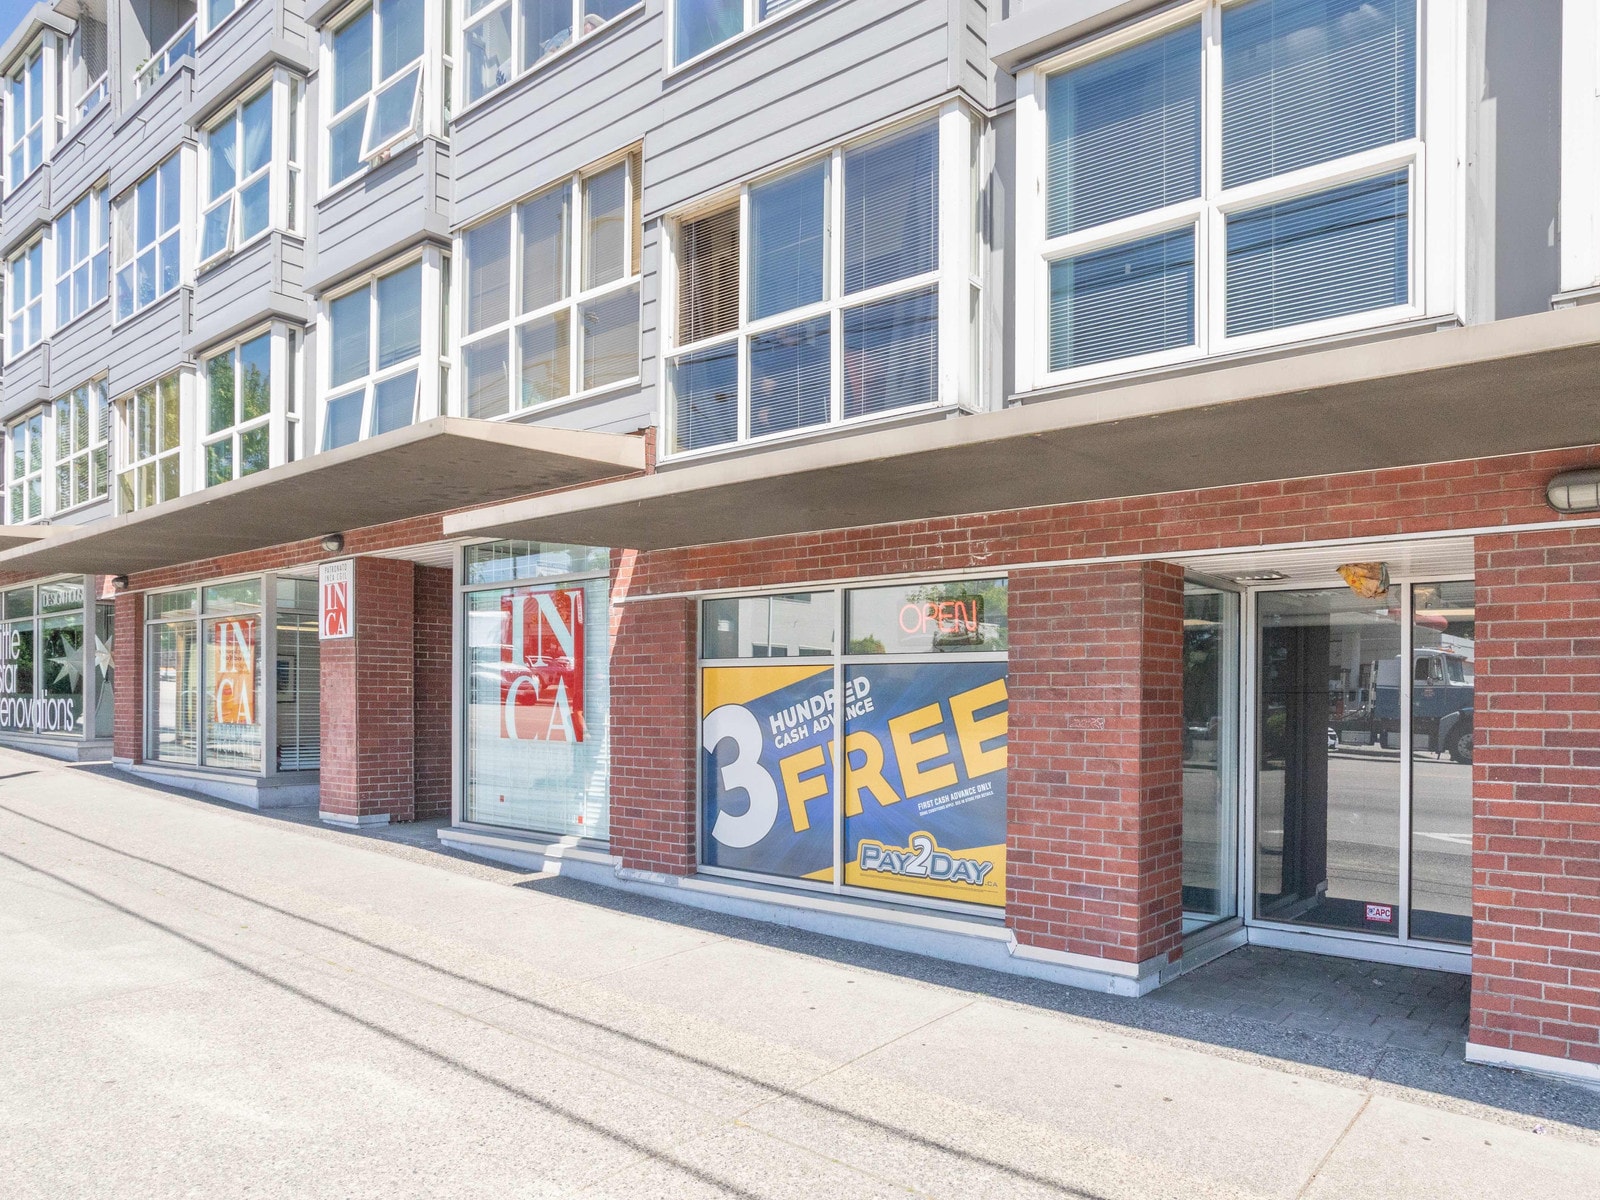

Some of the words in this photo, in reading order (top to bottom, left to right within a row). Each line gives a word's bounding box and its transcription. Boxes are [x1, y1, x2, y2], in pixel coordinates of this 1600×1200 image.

[899, 600, 977, 633] OPEN
[769, 676, 871, 735] HUNDRED
[774, 725, 809, 749] CASH
[813, 697, 875, 734] ADVNCE
[702, 704, 779, 848] 3
[779, 678, 1008, 833] FREE
[917, 801, 934, 810] FIRST
[934, 795, 950, 805] CASH
[950, 787, 976, 801] ADVANCE
[976, 782, 992, 793] ONLY
[1375, 908, 1391, 918] APC
